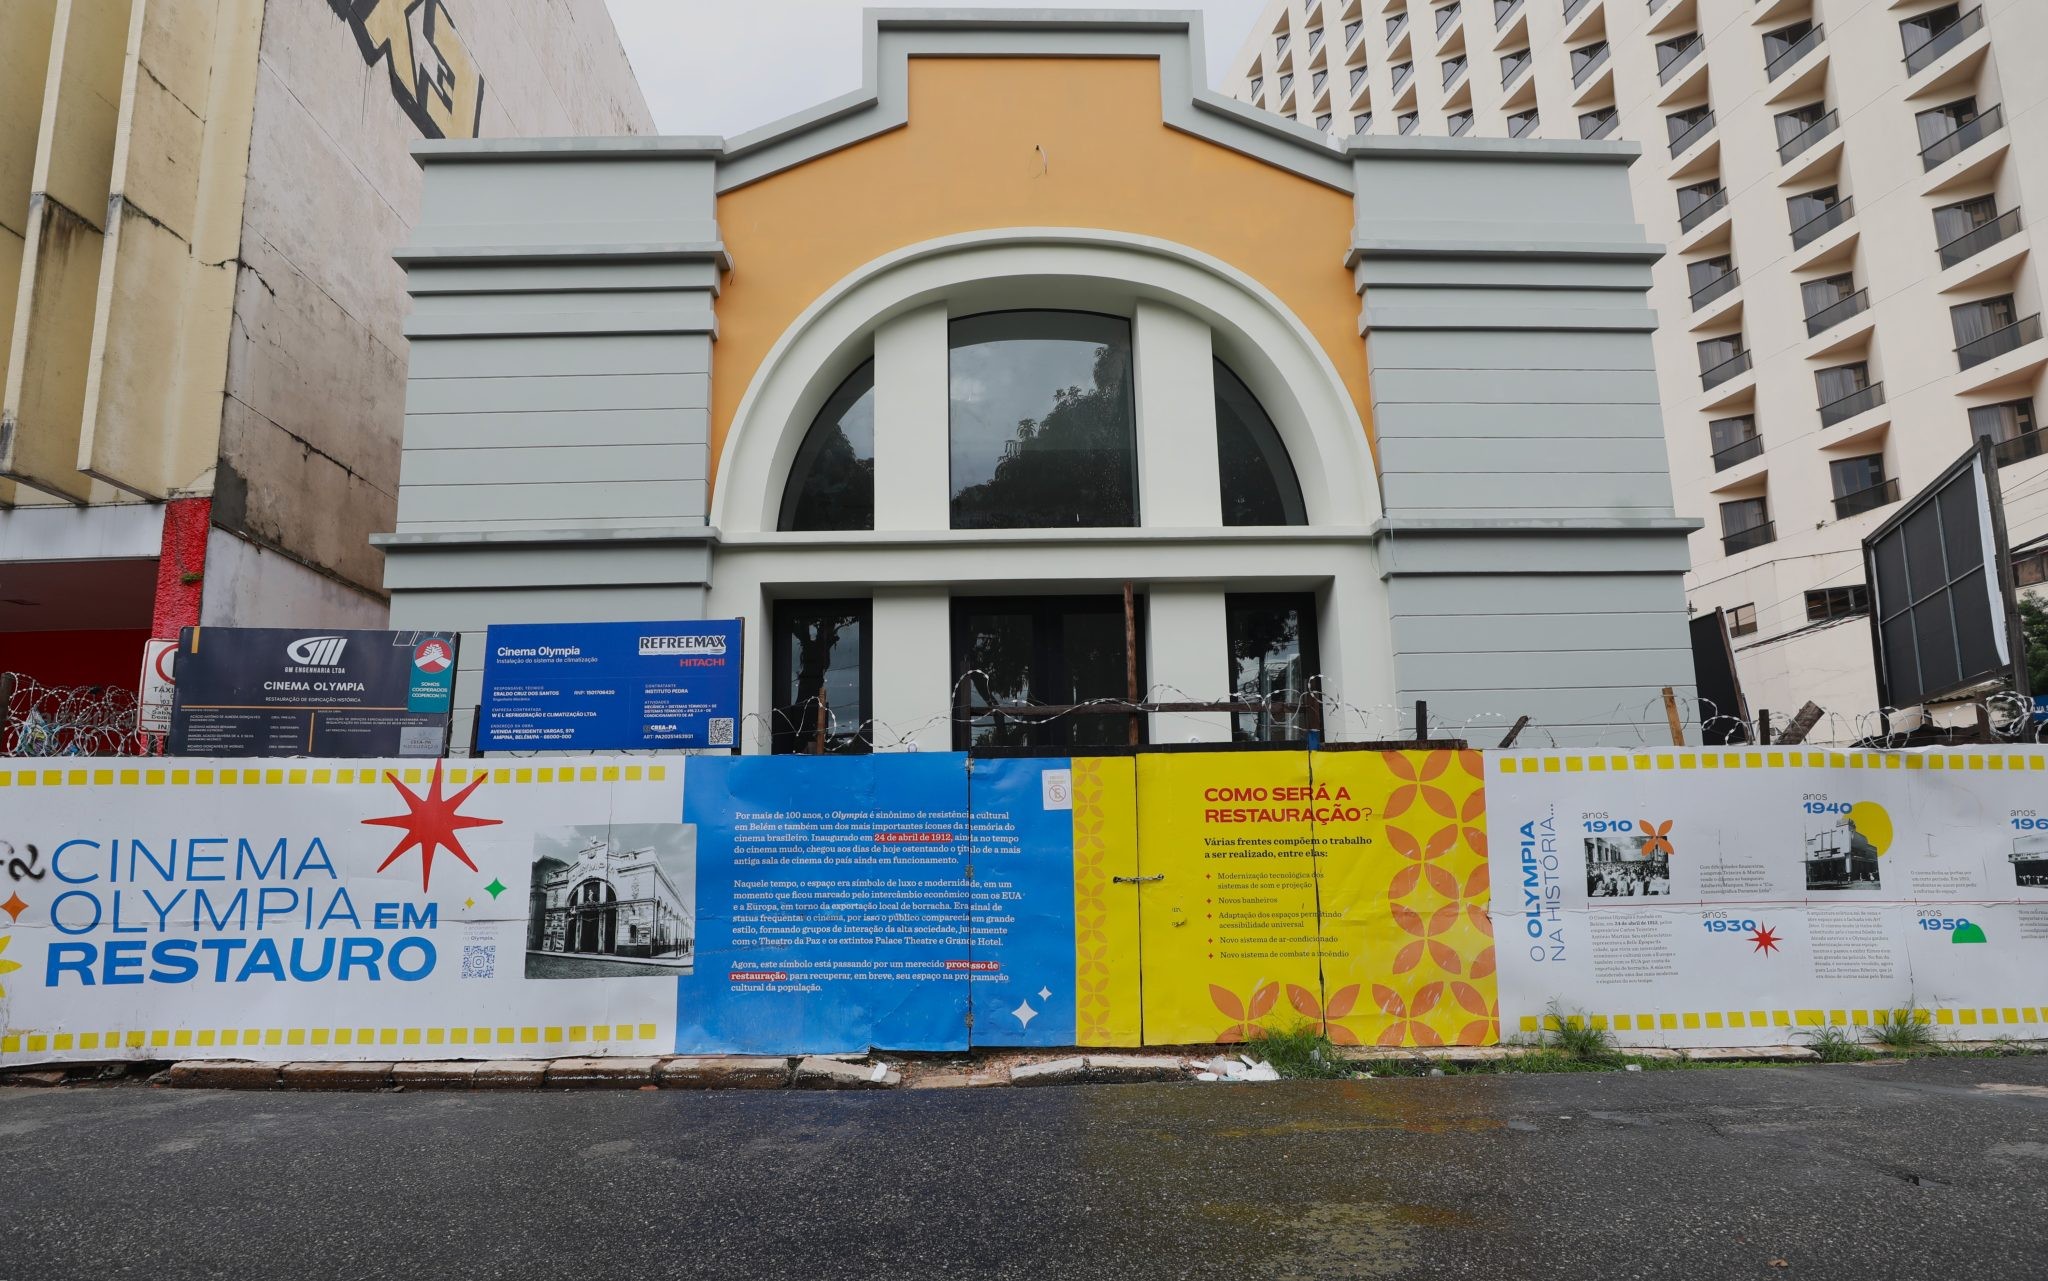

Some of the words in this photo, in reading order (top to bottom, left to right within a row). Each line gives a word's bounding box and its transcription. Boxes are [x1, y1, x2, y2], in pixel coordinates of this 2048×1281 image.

[641, 636, 725, 649] REFREEMAX
[497, 647, 536, 656] Cinema
[538, 646, 580, 657] Olympia
[680, 659, 725, 667] HITACHI
[264, 682, 310, 690] CINEMA
[314, 682, 365, 691] OLYMPIA
[1204, 787, 1267, 802] COMO
[1272, 783, 1331, 801] SERÁ
[1335, 786, 1351, 800] A
[1802, 793, 1827, 801] anos
[1803, 802, 1853, 814] 1940
[2010, 808, 2036, 817] anos
[832, 811, 868, 820] Olympia
[876, 811, 915, 819] sinônimo
[1205, 804, 1373, 825] RESTAURAÇÃO?
[1582, 811, 1609, 819] anos
[750, 822, 776, 830] Belém
[784, 822, 818, 830] também
[872, 823, 922, 831] importantes
[925, 822, 952, 830] ícones
[953, 822, 963, 830] da
[1583, 820, 1632, 832] 1910
[811, 834, 858, 842] Inaugurado
[932, 834, 952, 842] 1912,
[992, 835, 1019, 844] tempo
[1204, 837, 1236, 846] Várias
[1237, 837, 1272, 845] frentes
[1274, 837, 1320, 847] compõem
[1329, 837, 1372, 845] trabalho
[780, 846, 805, 854] mudo,
[806, 845, 836, 853] chegou
[883, 845, 900, 853] hoje
[1229, 850, 1276, 859] realizado,
[51, 837, 338, 884] CINEMA
[734, 858, 760, 866] antiga
[836, 857, 852, 865] país
[854, 856, 877, 864] ainda
[893, 856, 959, 864] funcionamento.
[1218, 872, 1268, 881] Modernização
[1269, 871, 1310, 880] tecnológica
[1520, 821, 1543, 938] OLYMPIA
[1218, 882, 1249, 890] sistemas
[1282, 882, 1312, 890] projeção
[50, 887, 361, 935] OLYMPIA
[373, 902, 438, 930] EM
[1219, 912, 1256, 920] Adaptação
[1701, 910, 1727, 919] anos
[1917, 908, 1942, 917] anos
[1704, 919, 1756, 933] 1930
[1919, 918, 1970, 931] 1950
[1550, 928, 1566, 961] NA
[1530, 946, 1545, 962] O
[45, 936, 438, 987] RESTAURO
